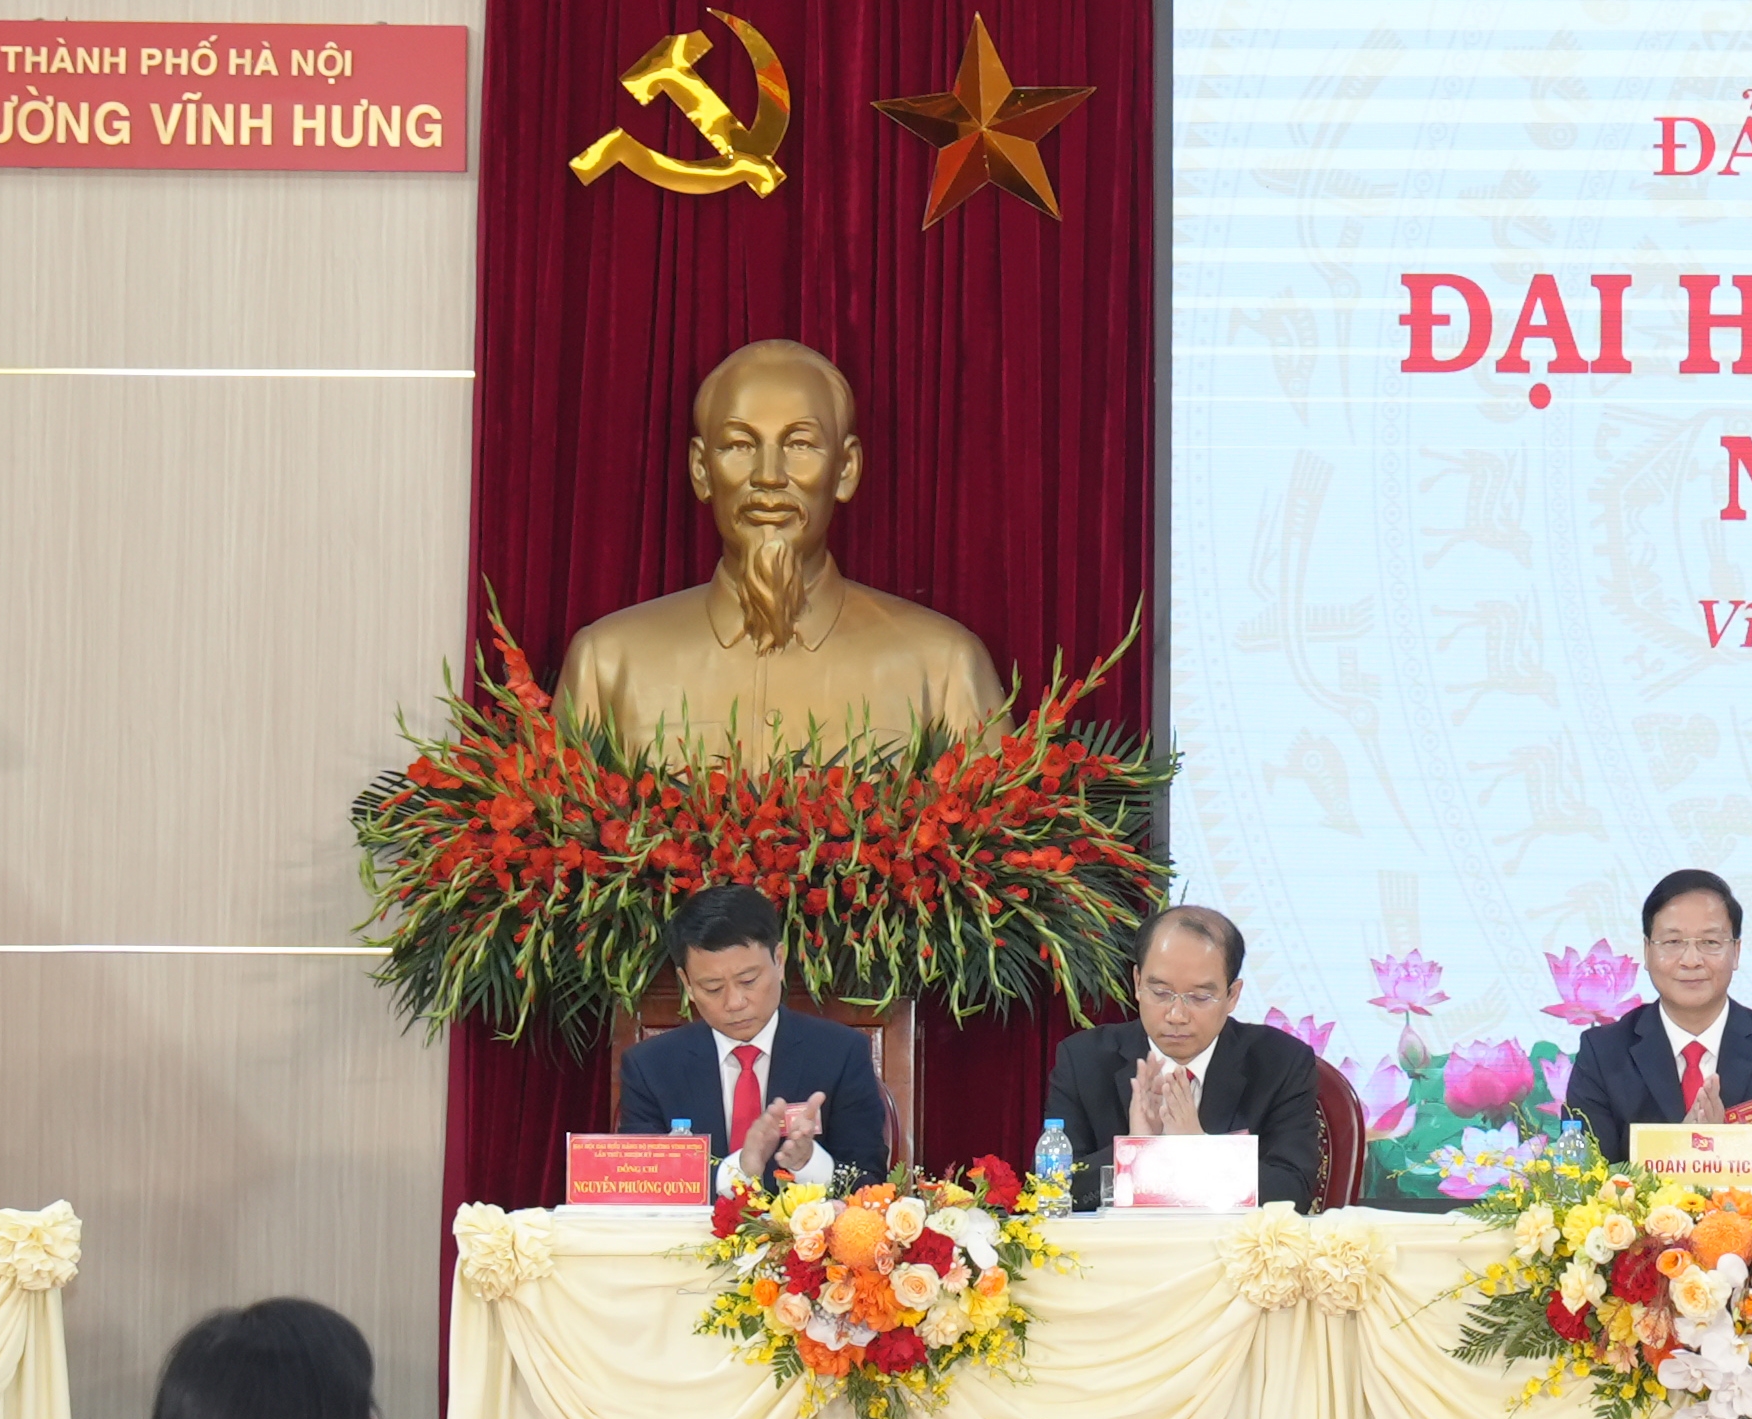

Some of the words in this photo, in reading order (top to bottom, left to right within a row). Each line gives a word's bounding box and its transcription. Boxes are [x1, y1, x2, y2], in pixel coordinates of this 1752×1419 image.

[0, 37, 127, 75] THÀNH
[140, 34, 218, 76] PHỐ
[228, 40, 279, 76] HÀ
[290, 40, 352, 85] NỘI
[149, 91, 272, 146] VĨNH
[292, 98, 442, 148] HƯNG
[1399, 273, 1633, 410] ĐẠI
[663, 1178, 700, 1196] QUỲNH
